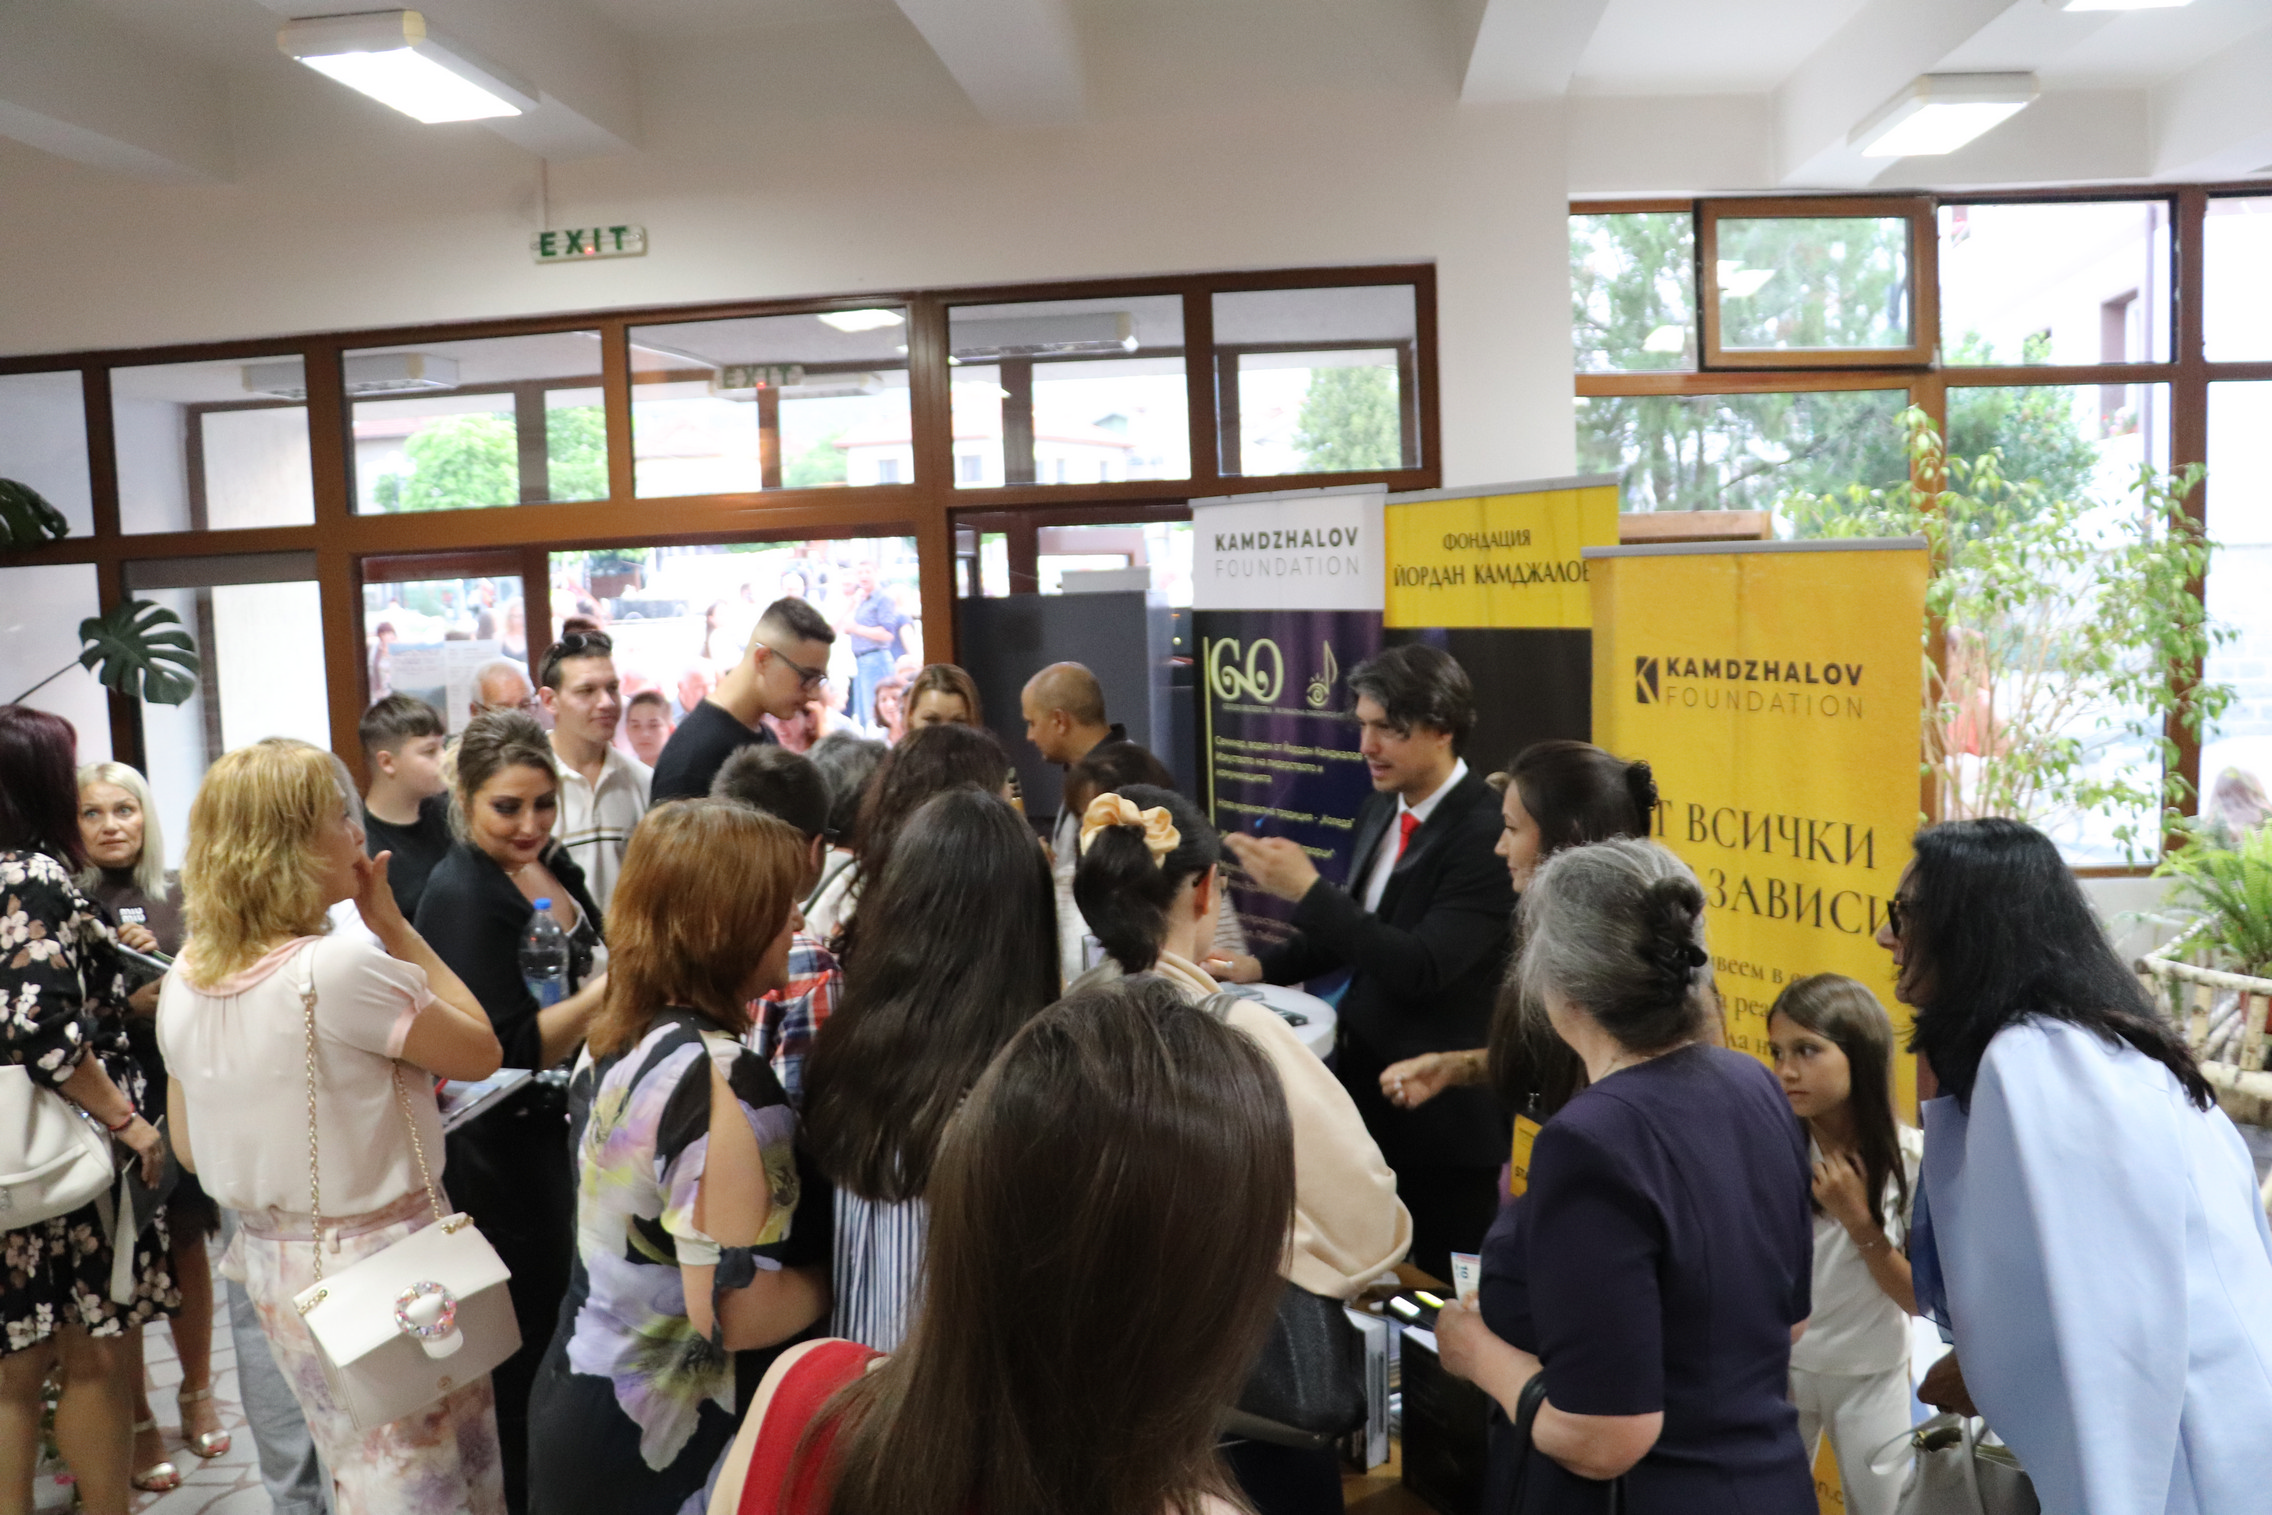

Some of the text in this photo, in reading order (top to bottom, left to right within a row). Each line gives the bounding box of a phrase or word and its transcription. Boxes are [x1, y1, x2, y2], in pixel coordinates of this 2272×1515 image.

[540, 226, 627, 257] EXIT
[722, 363, 791, 389] EXIT
[1214, 526, 1359, 551] KAMDZHALOV
[1442, 529, 1532, 551] ФОНДАЦИЯ
[1214, 555, 1360, 578] FOUNDATION
[1393, 563, 1466, 589] ЙОРДАН
[1666, 656, 1863, 686] KAMDZHALOV
[1666, 686, 1864, 719] FOUNDATION
[1652, 799, 1877, 870] Т ВСИЧКИ
[1712, 956, 1764, 981] веем
